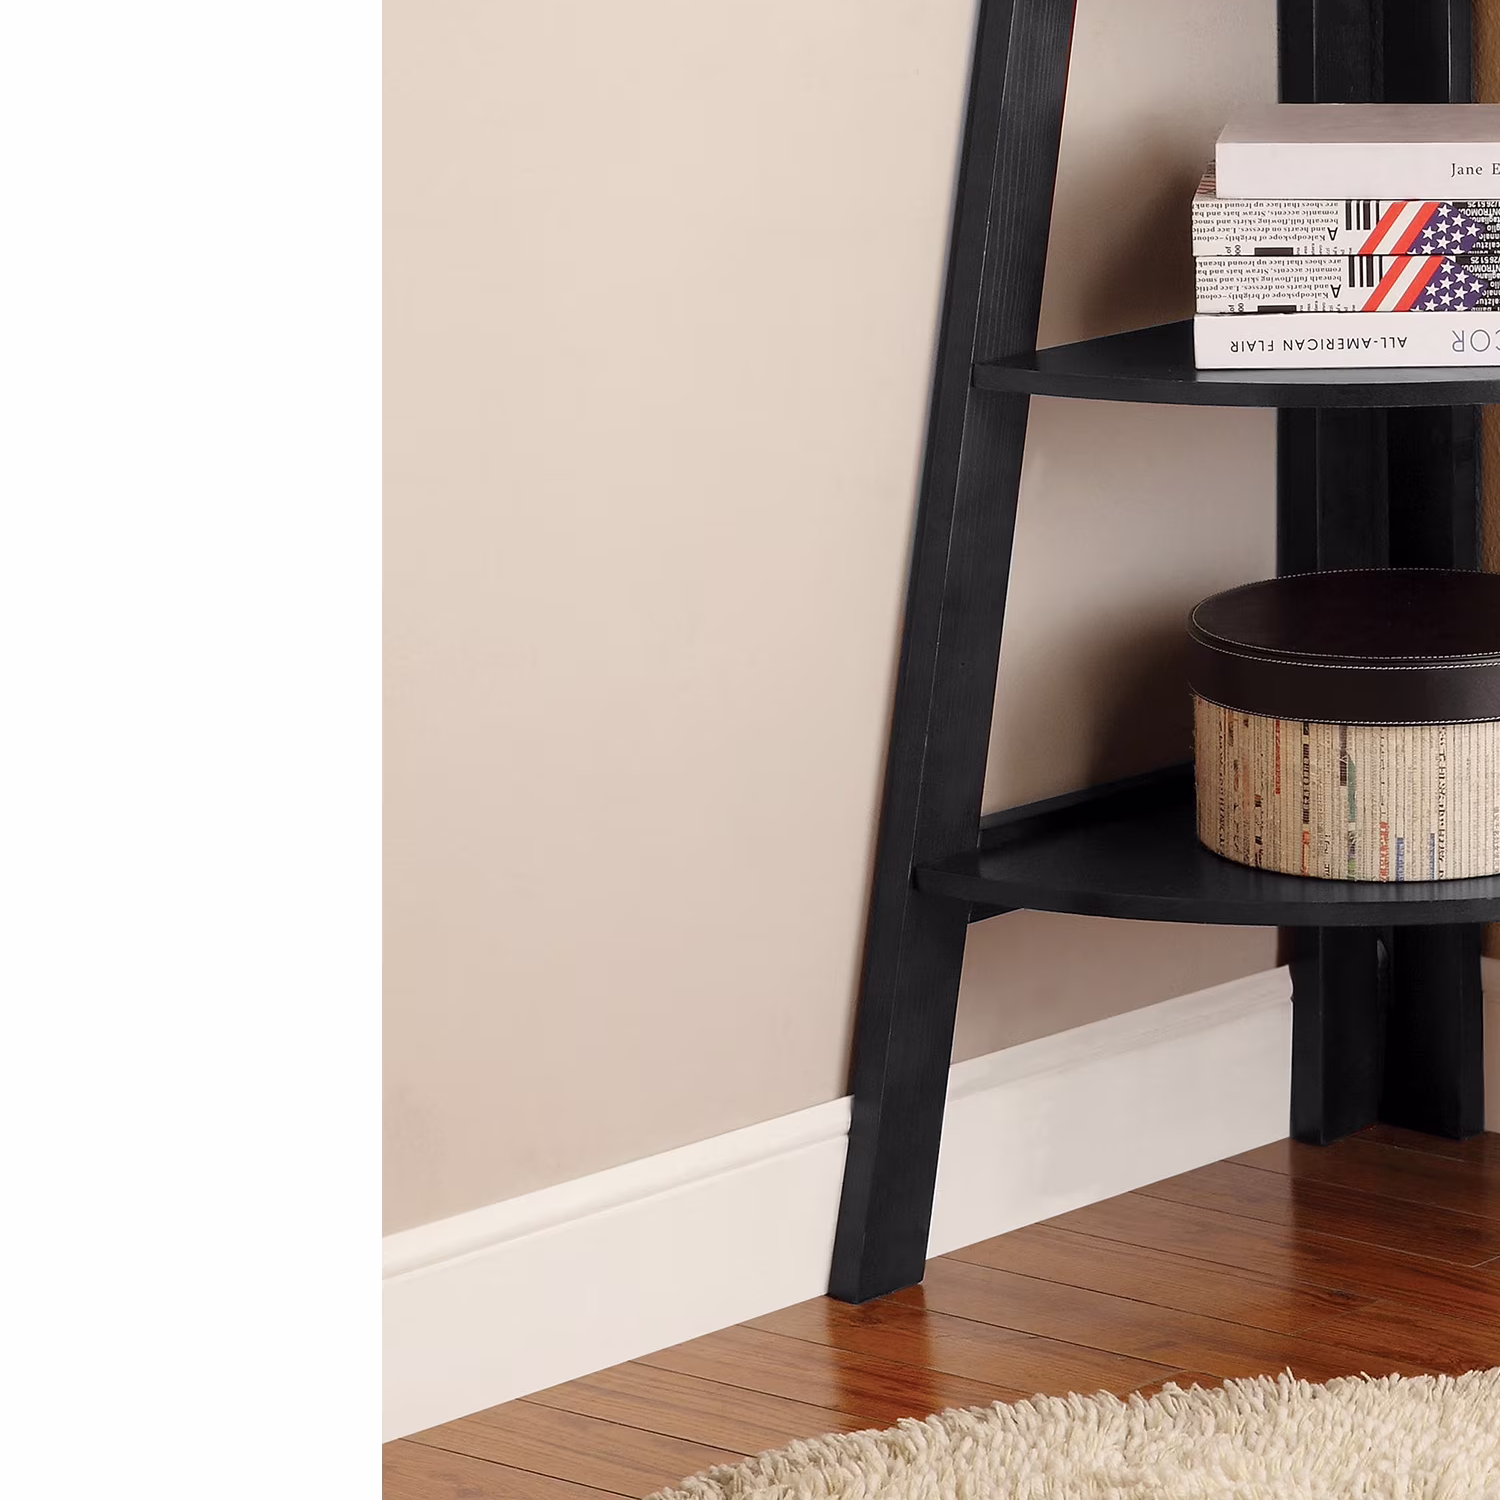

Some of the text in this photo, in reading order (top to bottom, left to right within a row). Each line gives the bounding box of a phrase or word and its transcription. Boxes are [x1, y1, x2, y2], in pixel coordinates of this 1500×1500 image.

[1451, 163, 1482, 177] Jane
[1327, 227, 1338, 241] A
[1330, 284, 1341, 298] A
[1231, 337, 1407, 352] ALL-AMERICAN FLAIR
